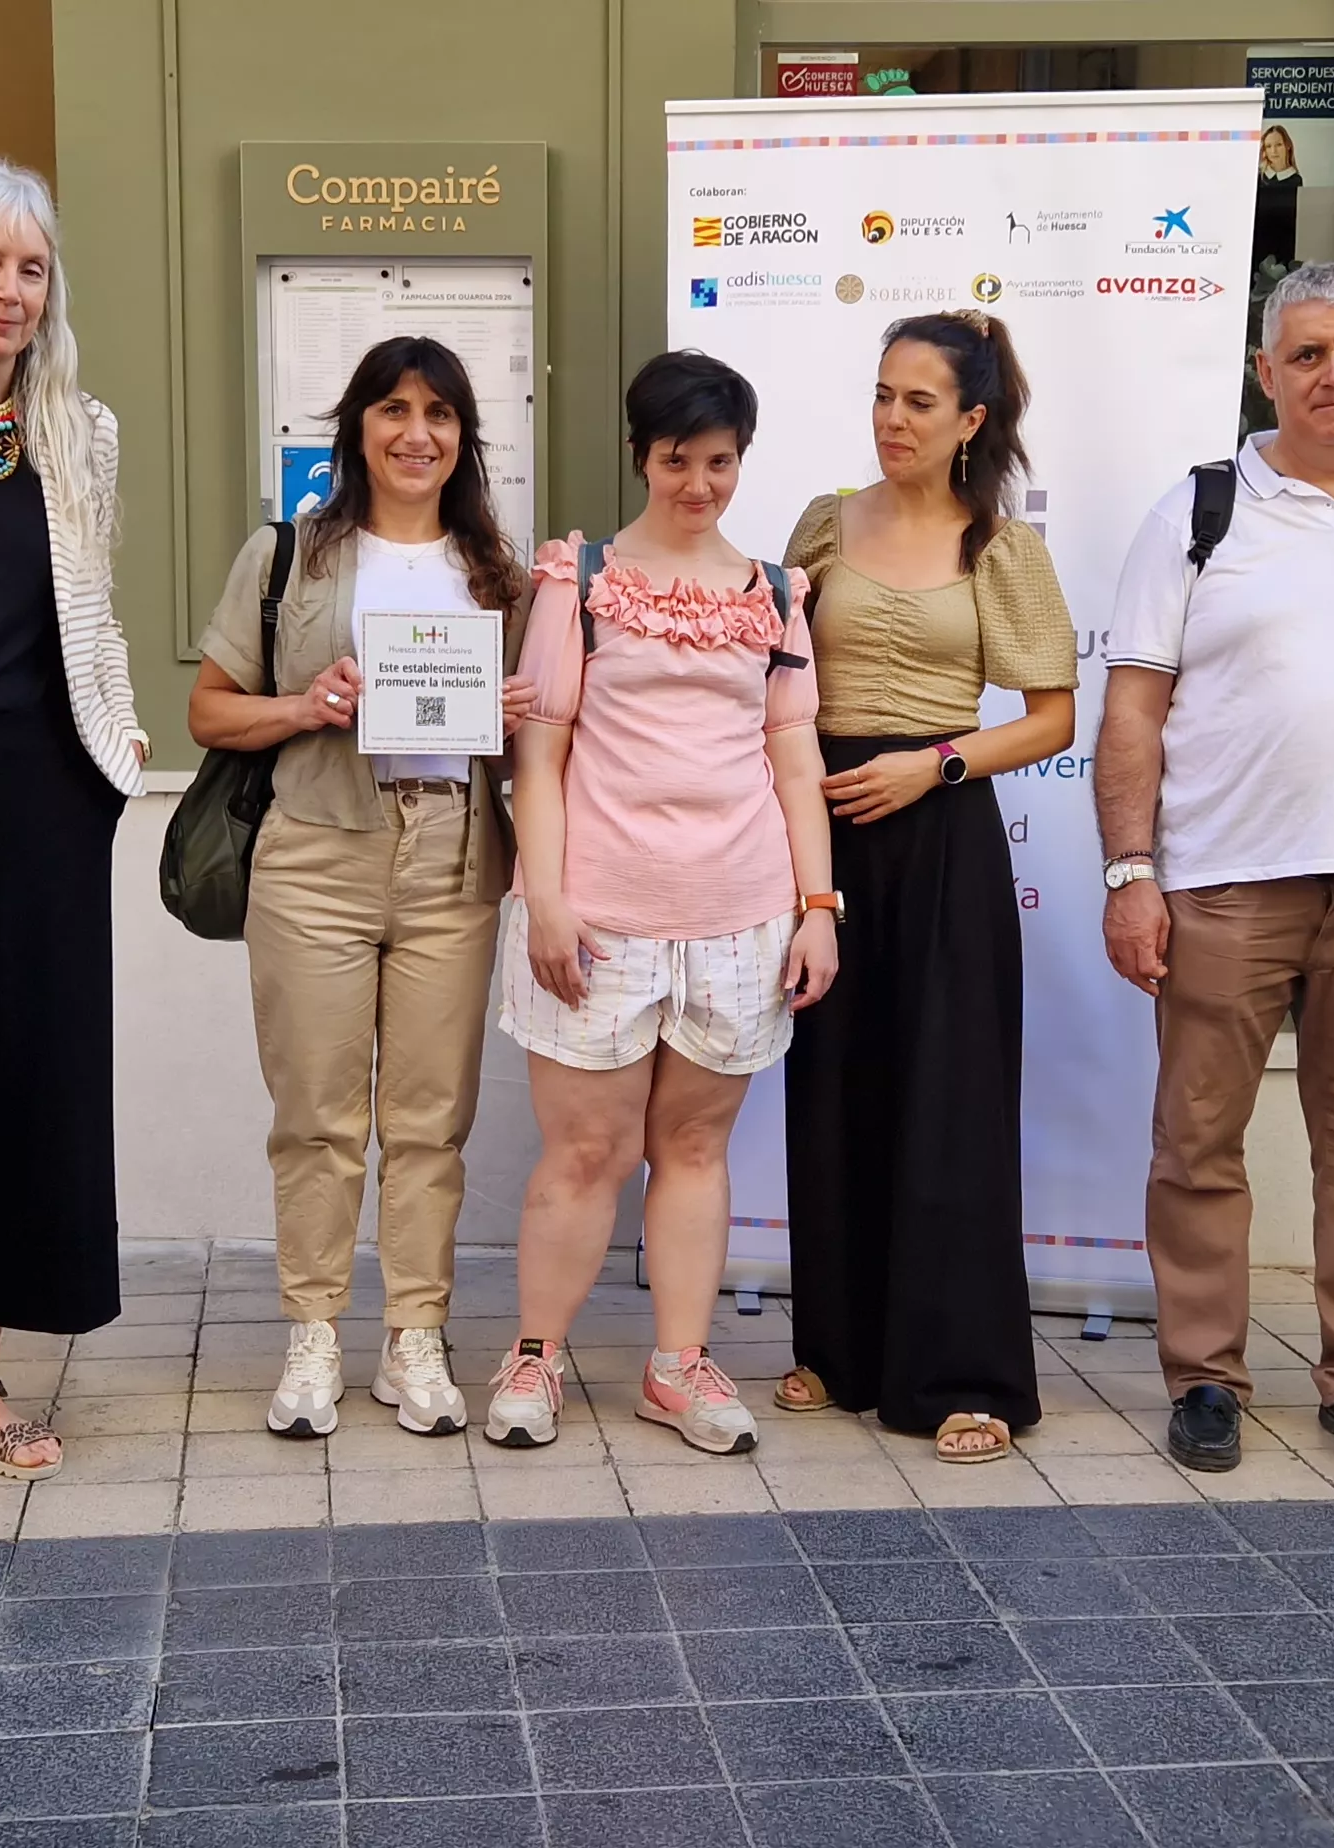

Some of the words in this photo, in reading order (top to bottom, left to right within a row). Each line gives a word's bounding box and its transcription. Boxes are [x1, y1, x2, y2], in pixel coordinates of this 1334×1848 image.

[804, 71, 853, 81] COMERCIO
[1251, 67, 1305, 79] SERVICIO
[804, 82, 853, 92] HUESCA
[1269, 98, 1282, 109] TU
[287, 163, 501, 212] Compairé
[689, 186, 747, 198] Colaboran:
[900, 215, 965, 227] DIPUTACIÓN
[1037, 210, 1103, 221] Ayuntamiento
[322, 215, 467, 232] FARMACIA
[723, 213, 807, 231] GOBIERNO
[1037, 222, 1048, 231] de
[1051, 221, 1087, 231] Huesca
[900, 227, 964, 236] HUESCA
[724, 232, 744, 247] DE
[749, 229, 819, 246] ARAGON
[1125, 244, 1175, 255] Fundación
[726, 271, 822, 288] cadishuesca
[1006, 279, 1084, 289] Ayuntamiento
[1096, 276, 1196, 294] avanza
[869, 287, 957, 302] SOBRARBE
[1019, 289, 1085, 299] Sabiñánigo
[501, 477, 526, 485] 20:00
[388, 645, 417, 654] Huesca
[419, 645, 435, 654] más
[438, 646, 473, 655] inclusiva
[379, 662, 399, 673] Este
[402, 663, 483, 674] establecimiento
[375, 678, 426, 689] promueve
[429, 677, 438, 688] la
[441, 677, 486, 689] inclusión
